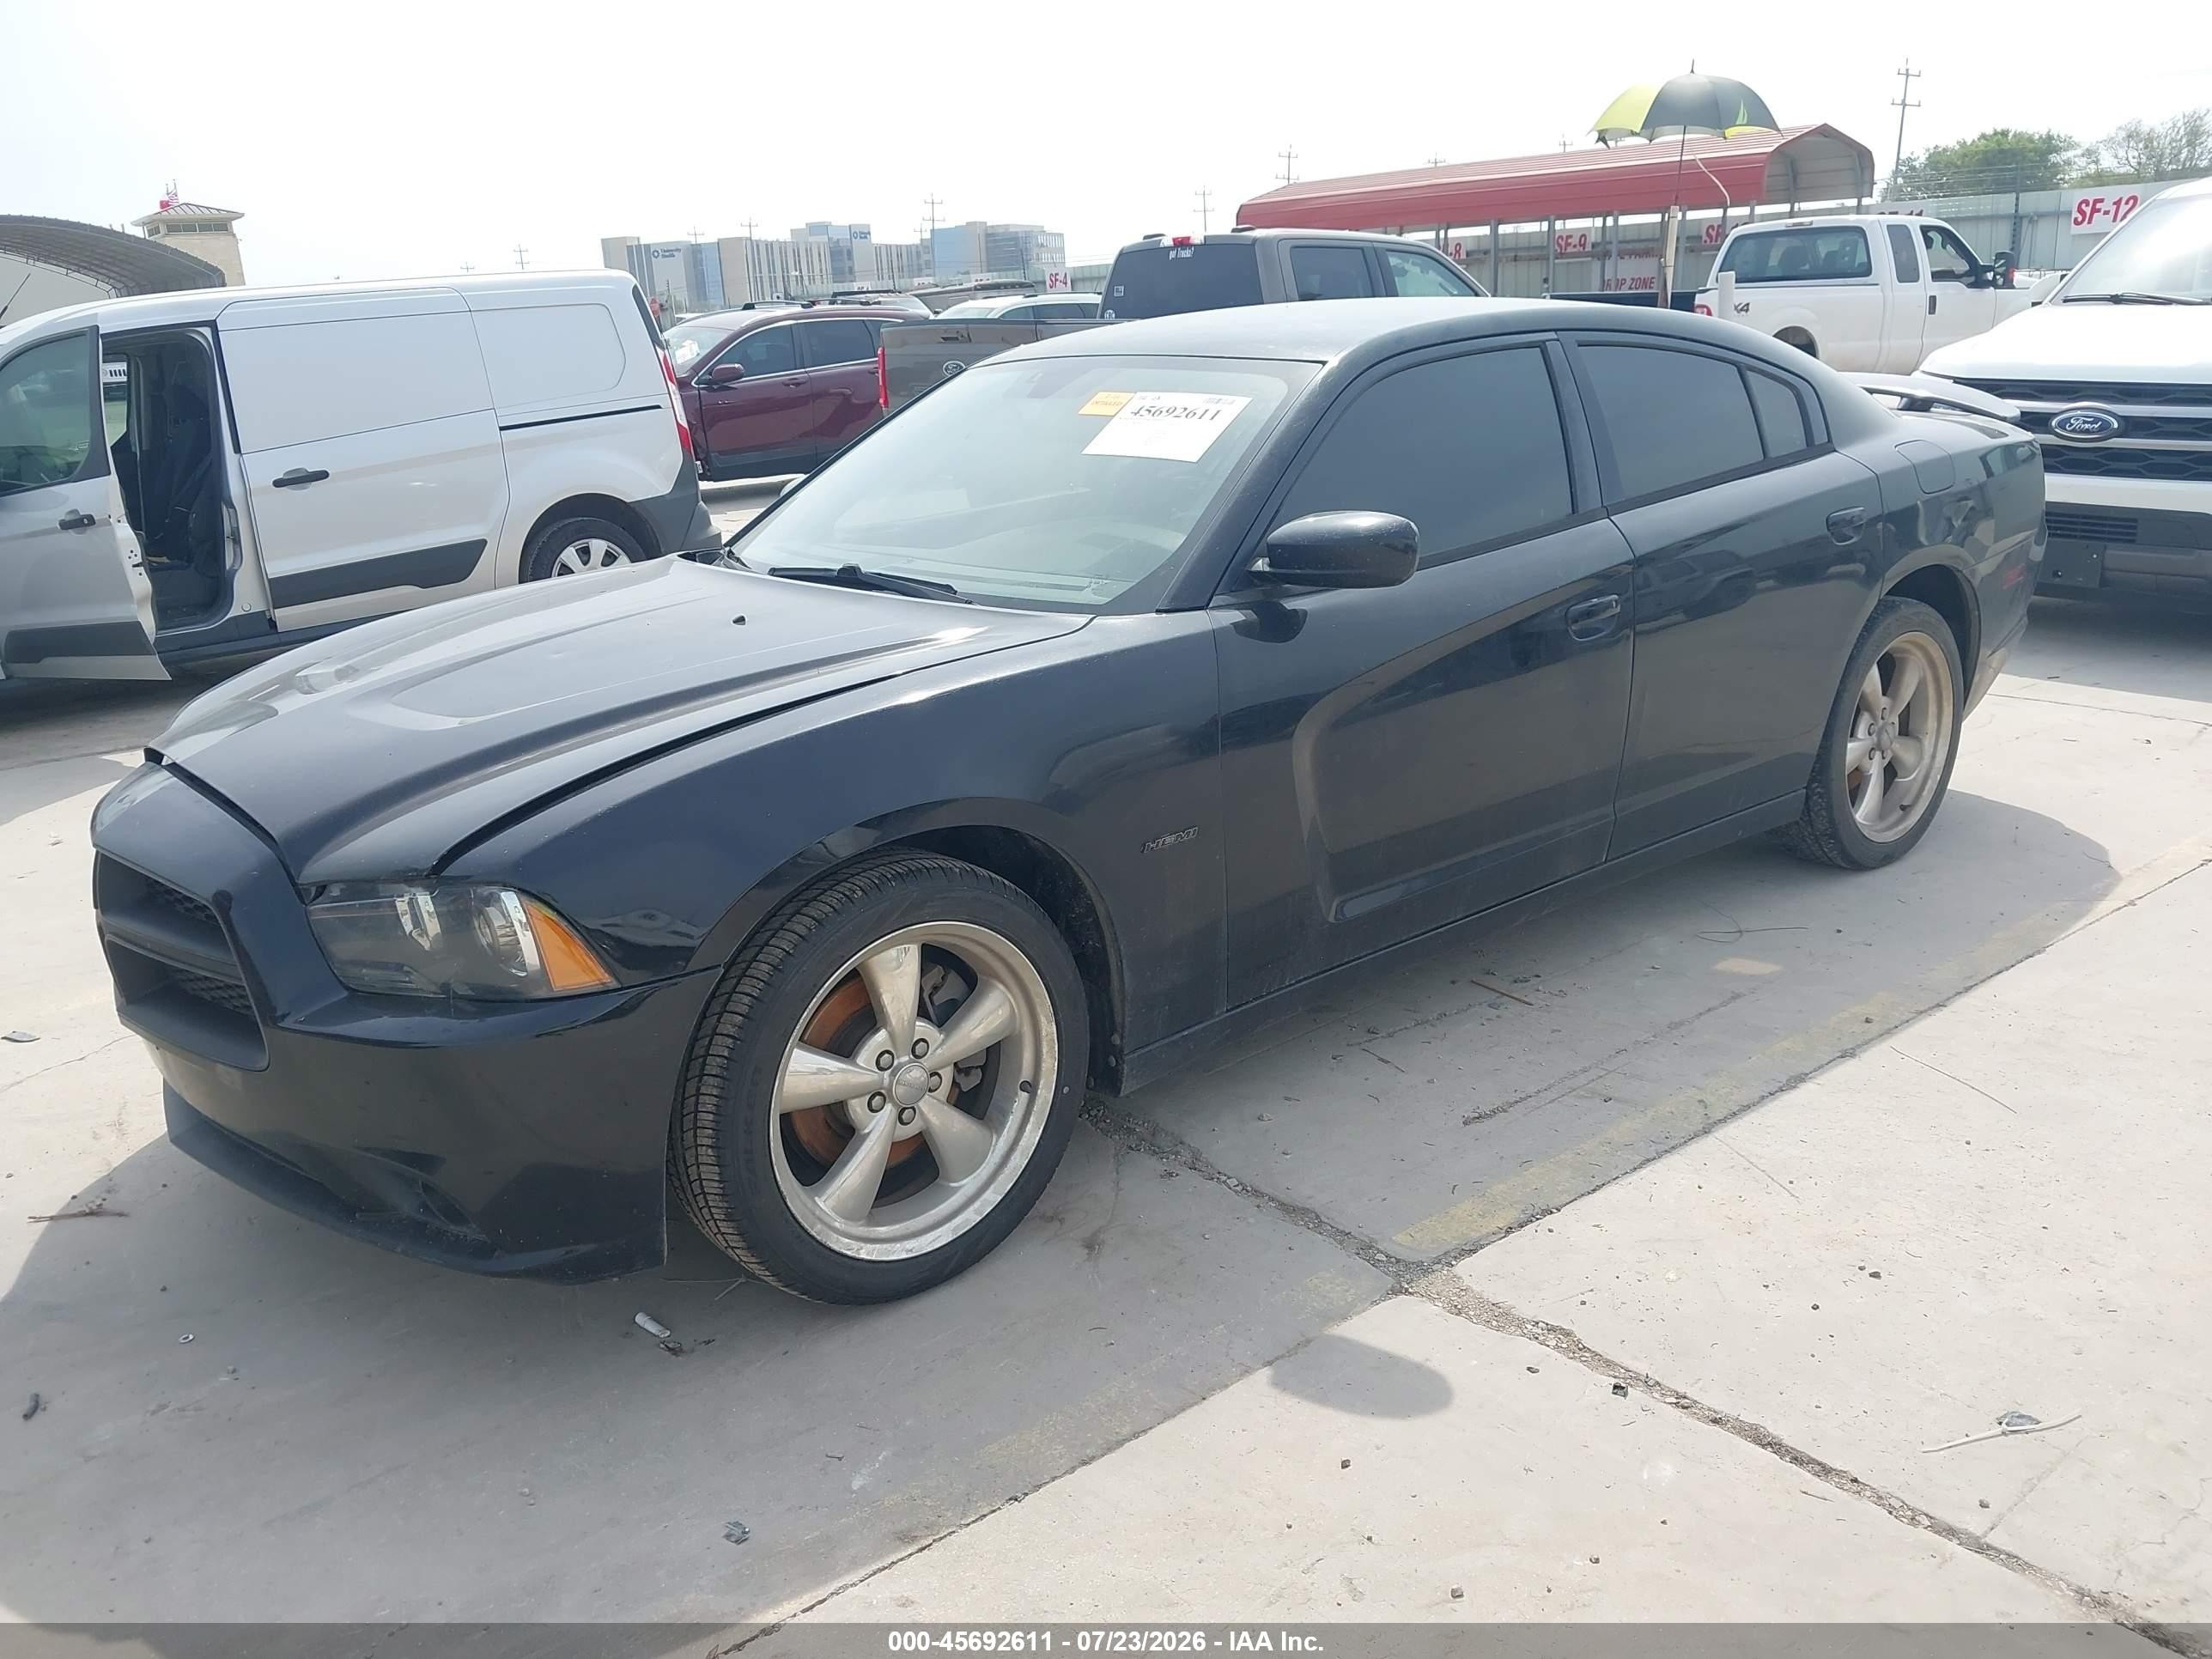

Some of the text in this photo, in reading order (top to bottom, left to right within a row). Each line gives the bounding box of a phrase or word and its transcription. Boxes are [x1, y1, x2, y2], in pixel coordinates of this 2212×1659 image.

[2073, 195, 2139, 226] SF-12
[1556, 233, 1587, 254] SF-9
[1048, 272, 1067, 289] SF-4
[1628, 276, 1656, 289] ZONE
[1130, 404, 1223, 421] 45692611
[2066, 416, 2103, 432] Ford
